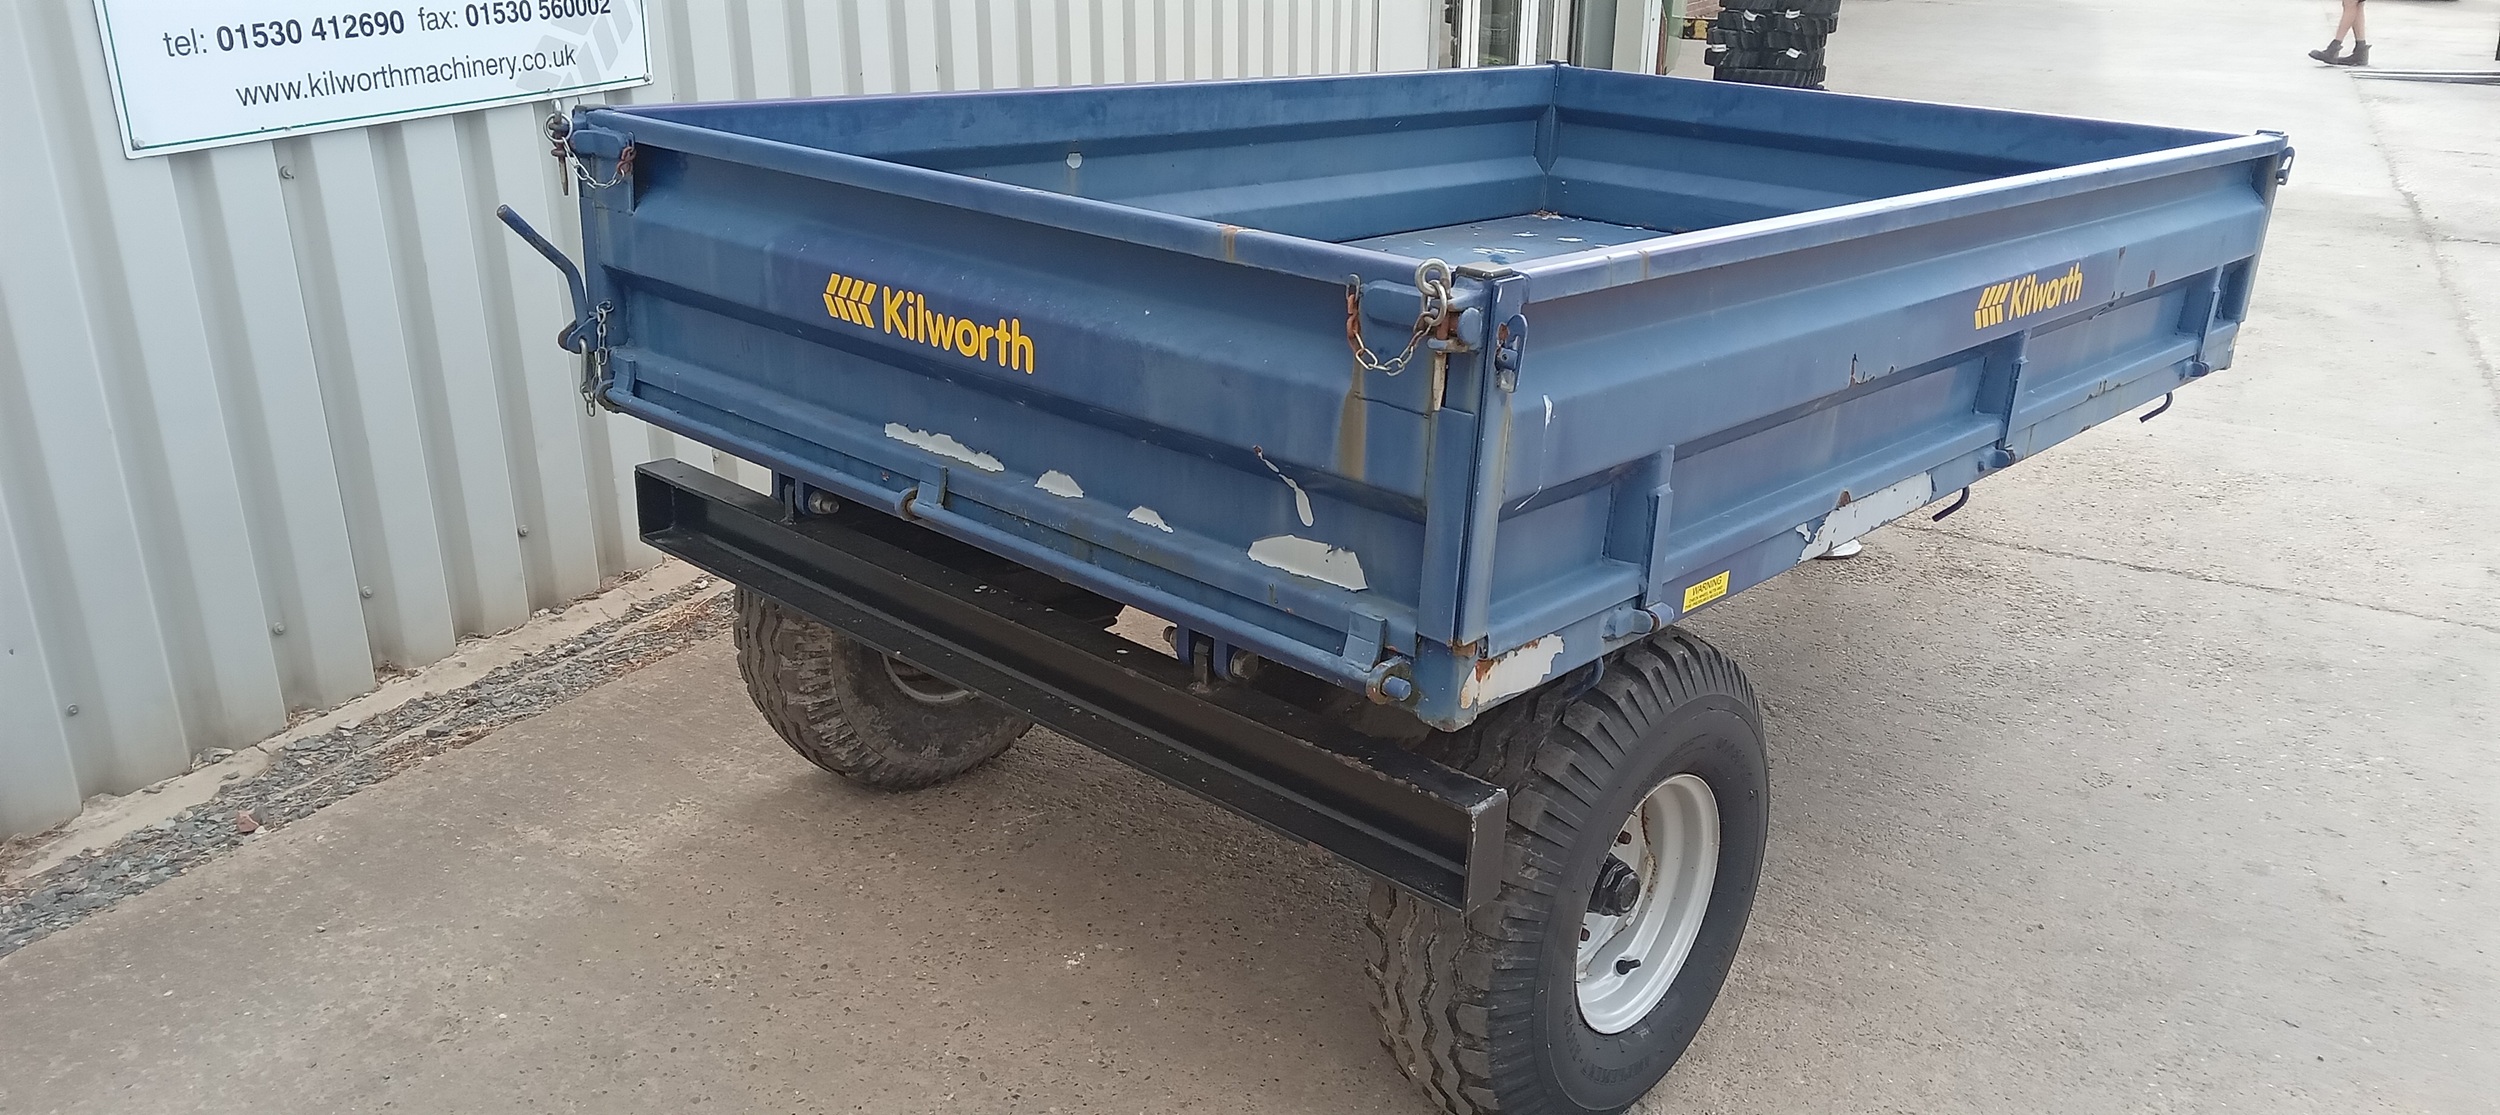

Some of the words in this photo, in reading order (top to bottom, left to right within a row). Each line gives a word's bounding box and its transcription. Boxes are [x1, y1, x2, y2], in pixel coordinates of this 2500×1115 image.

[163, 28, 208, 57] tel:
[216, 19, 302, 51] 01530
[311, 10, 405, 41] 412690
[418, 7, 459, 31] fax:
[465, 0, 532, 27] 01530
[539, 0, 612, 20] 560002
[235, 44, 577, 107] www.kilworthmachinery.co.uk
[2008, 262, 2083, 321] Kilworth
[883, 286, 1034, 375] Kilworth
[1692, 576, 1722, 596] WARNING
